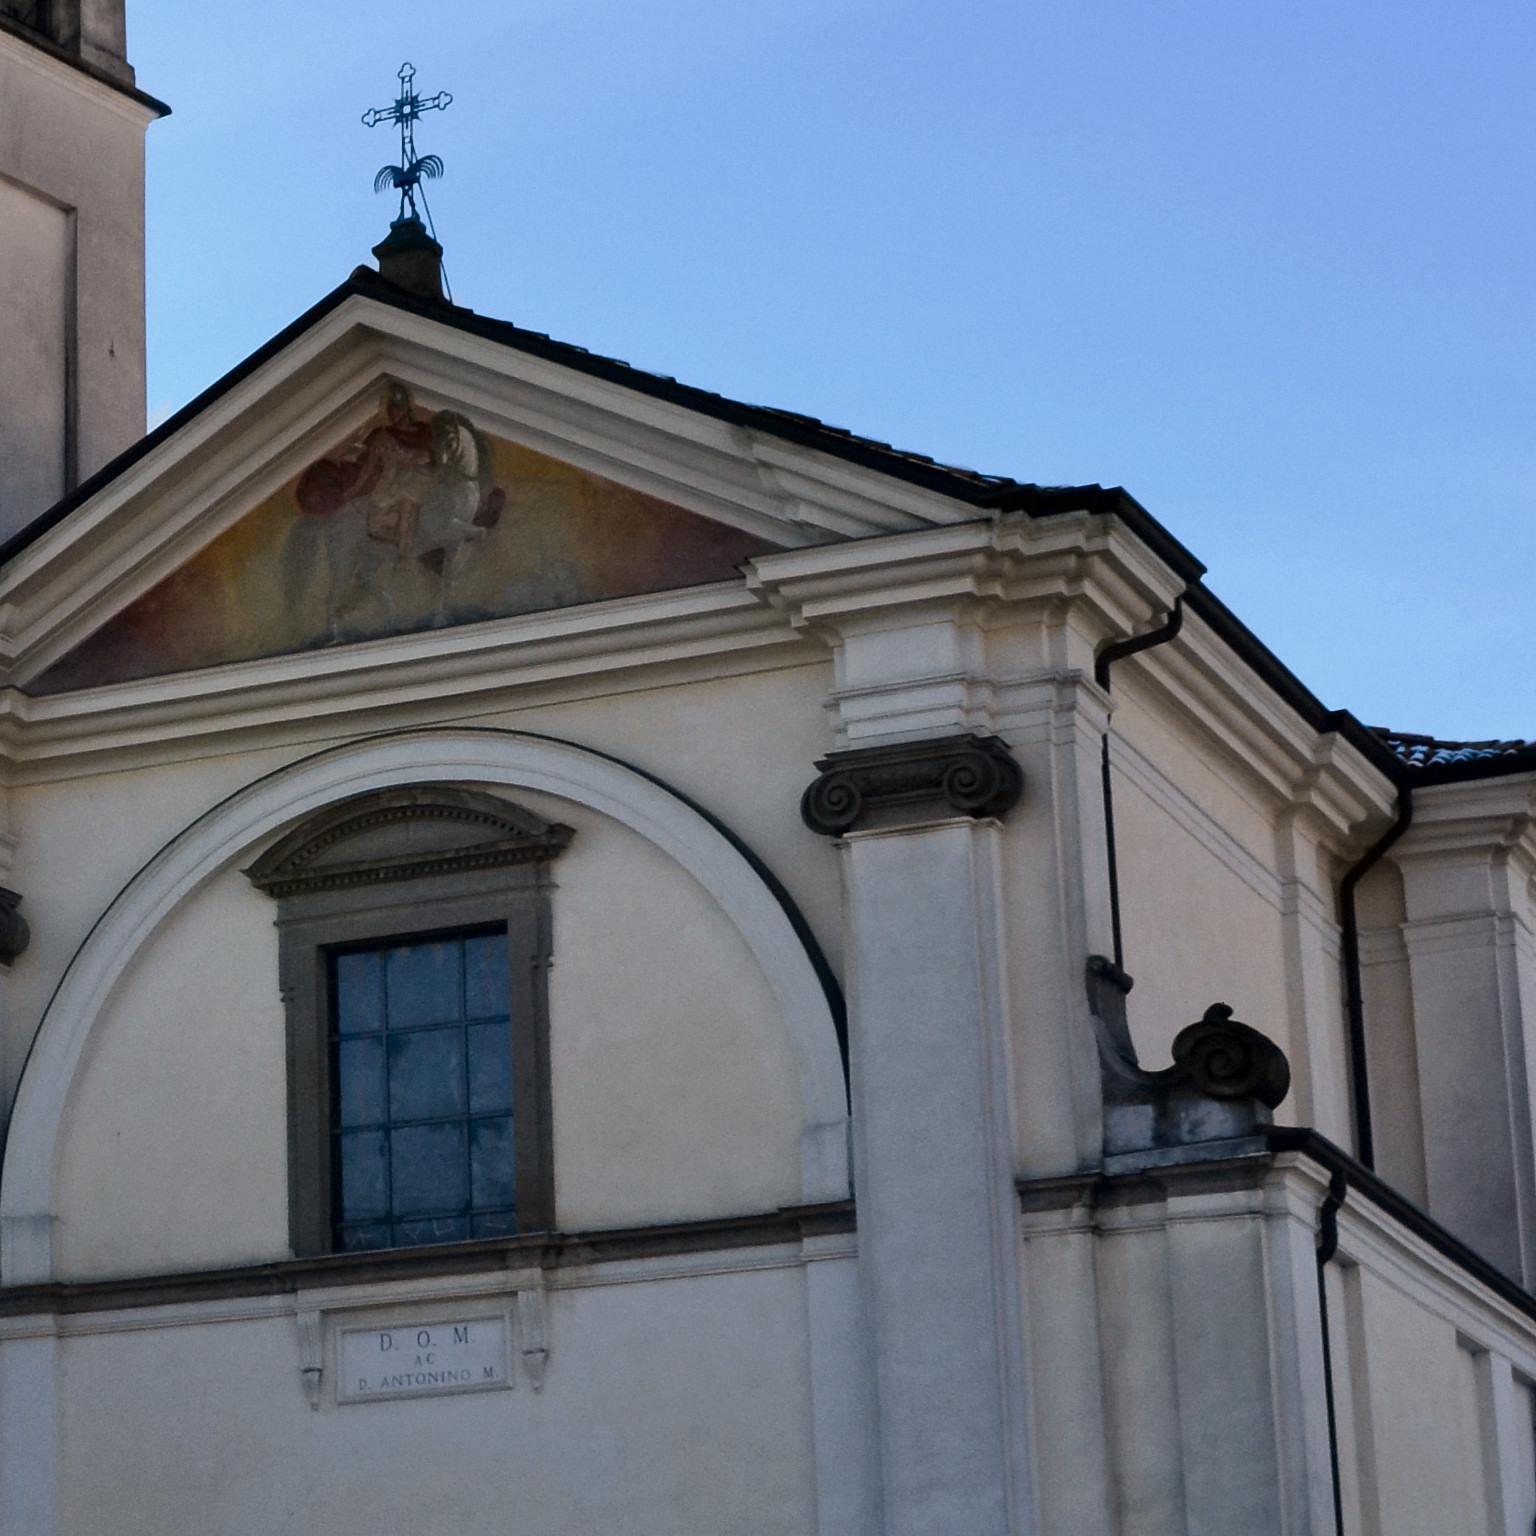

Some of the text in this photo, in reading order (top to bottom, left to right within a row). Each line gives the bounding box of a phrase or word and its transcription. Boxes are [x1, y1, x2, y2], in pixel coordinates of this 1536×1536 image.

[416, 1329, 437, 1348] O.
[415, 1352, 436, 1367] AC
[380, 1368, 472, 1390] ANTONINO
